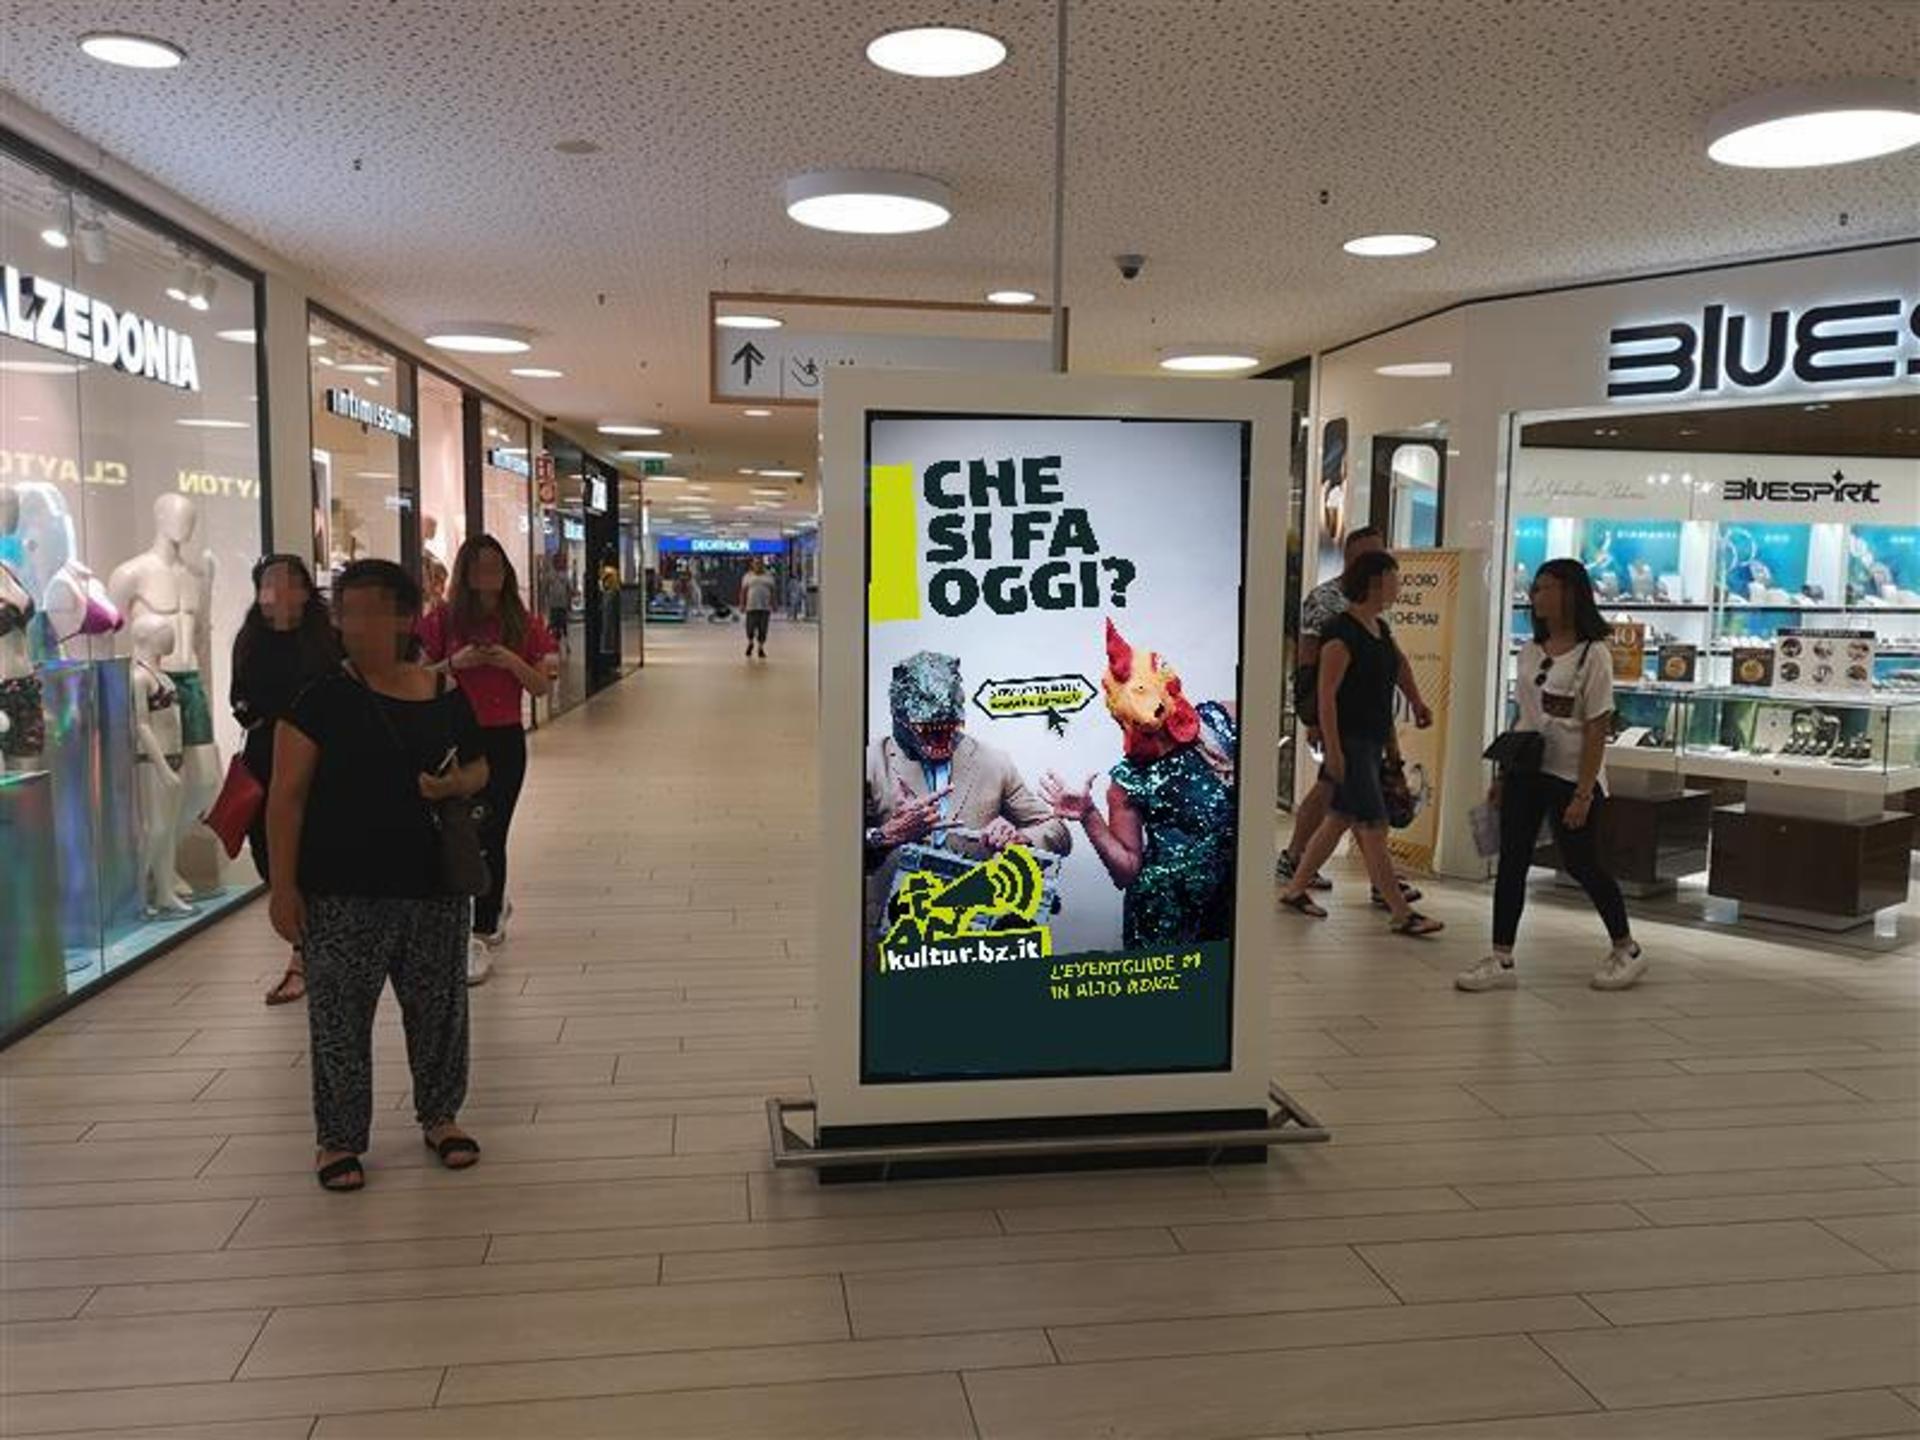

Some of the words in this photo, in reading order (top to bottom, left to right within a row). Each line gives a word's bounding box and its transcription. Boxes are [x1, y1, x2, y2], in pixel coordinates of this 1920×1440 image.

[923, 455, 1064, 509] CHE
[926, 513, 992, 564] SI
[1010, 508, 1100, 560] FA
[928, 556, 1136, 618] OGGI?
[887, 938, 1039, 971] kultur.bz.it
